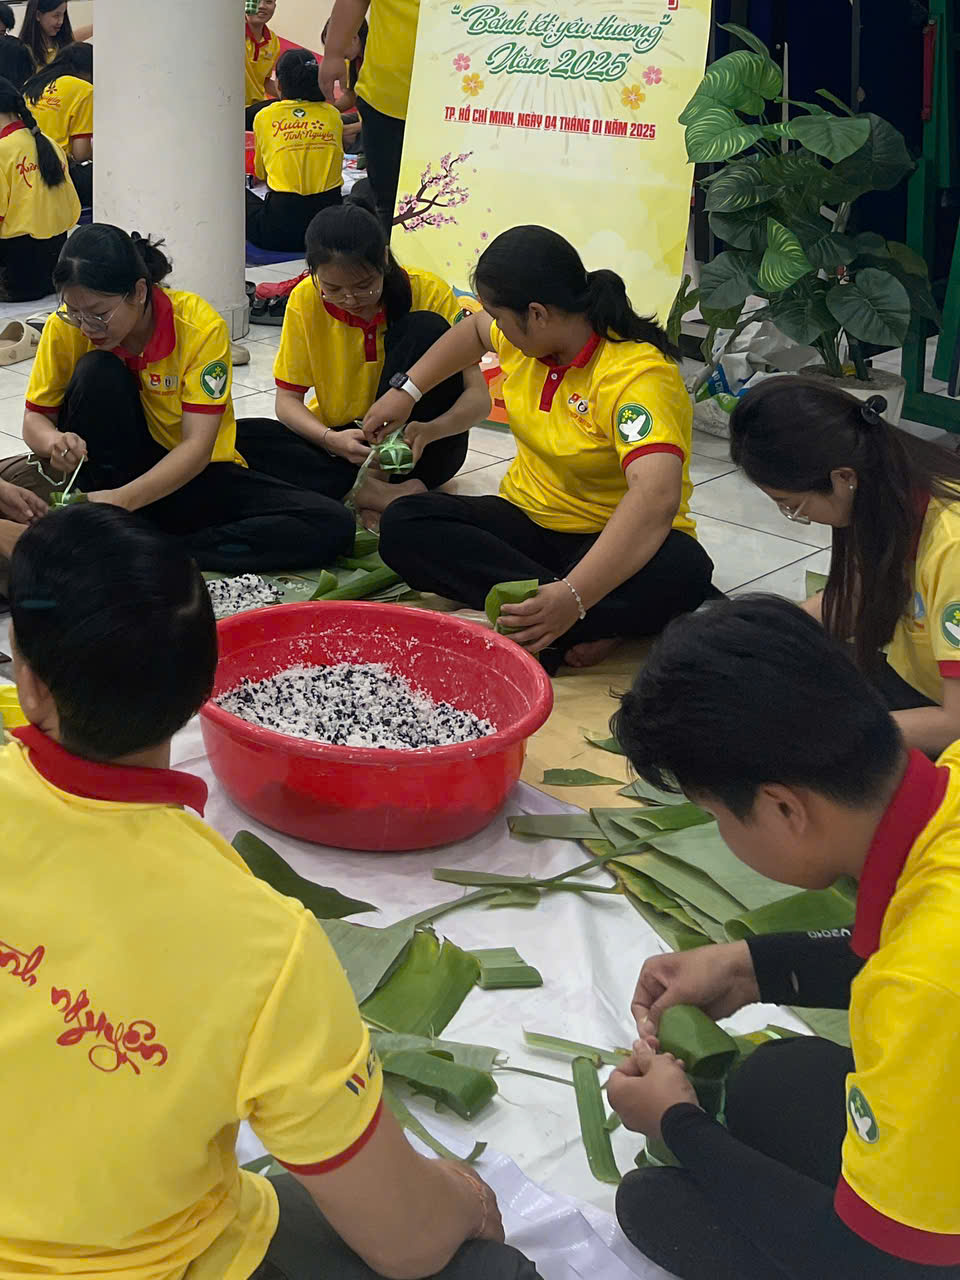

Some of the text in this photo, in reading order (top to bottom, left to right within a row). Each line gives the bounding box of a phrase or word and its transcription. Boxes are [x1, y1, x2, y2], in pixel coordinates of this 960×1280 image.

[541, 17, 592, 48] yêu
[485, 42, 632, 82] Năm 2025
[444, 106, 457, 121] TP.
[458, 104, 471, 123] HỒ
[472, 107, 488, 124] CHÍ
[516, 111, 543, 130] NGÀY
[544, 115, 557, 131] 04
[559, 115, 591, 134] THÁNG
[604, 118, 628, 137] NĂM
[629, 122, 656, 140] 2025
